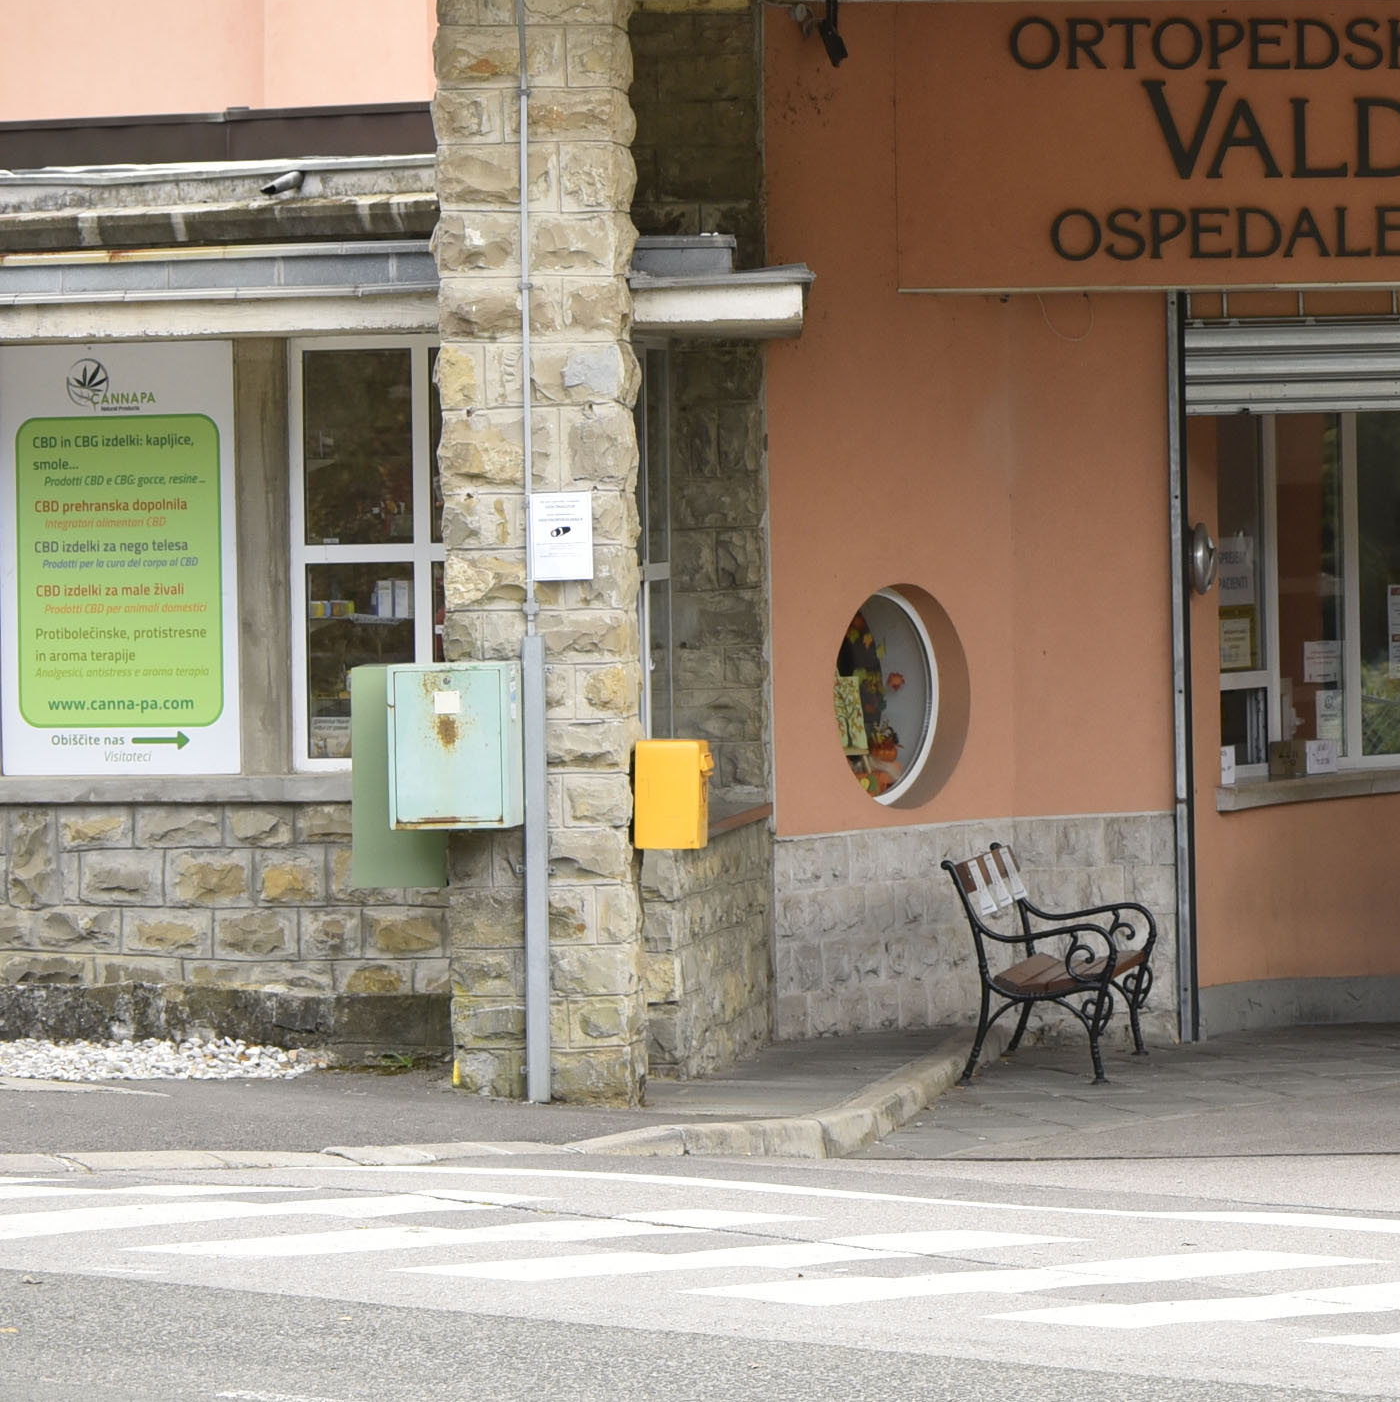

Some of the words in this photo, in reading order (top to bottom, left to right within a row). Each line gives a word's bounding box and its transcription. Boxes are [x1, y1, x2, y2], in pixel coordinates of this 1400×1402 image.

[90, 391, 156, 406] CANNAPA
[33, 436, 57, 449] CBD
[61, 436, 71, 448] in
[74, 435, 98, 448] CBG
[102, 434, 143, 447] izdelki:
[146, 434, 194, 450] kapljice,
[33, 458, 79, 471] smole...
[44, 475, 82, 487] Prodotti
[84, 475, 104, 486] CBD
[106, 477, 112, 485] e
[137, 476, 167, 488] gocce,
[34, 500, 59, 513] CBD
[63, 499, 129, 515] prehranska
[132, 498, 188, 513] dopolnila
[45, 517, 94, 531] Integratori
[96, 517, 144, 528] alimentari
[146, 516, 167, 527] CBD
[34, 541, 59, 553] CBD
[62, 540, 100, 553] izdelki
[103, 542, 116, 553] za
[119, 541, 149, 555] nego
[152, 539, 188, 552] telesa
[42, 559, 78, 569] Prodotti
[79, 560, 94, 571] per
[96, 559, 104, 568] la
[106, 560, 126, 568] cura
[128, 558, 141, 568] del
[143, 559, 167, 569] corpo
[180, 557, 199, 567] CBD
[36, 584, 61, 598] CBD
[64, 584, 101, 597] izdelki
[105, 586, 118, 597] za
[121, 583, 151, 596] male
[153, 582, 185, 595] živali
[45, 604, 82, 615] Prodotti
[84, 603, 104, 614] CBD
[106, 605, 122, 616] per
[124, 603, 160, 613] animali
[161, 602, 208, 613] domestici
[35, 626, 130, 641] Protibolečinske,
[133, 626, 207, 641] protistresne
[35, 649, 47, 662] in
[49, 651, 87, 662] aroma
[90, 649, 136, 664] terapije
[86, 667, 132, 678] antistress
[142, 668, 173, 677] aroma
[48, 698, 195, 714] www.canna-pa.com
[51, 734, 101, 746] Obiščite
[104, 735, 125, 746] nas
[104, 750, 152, 763] Visitateci
